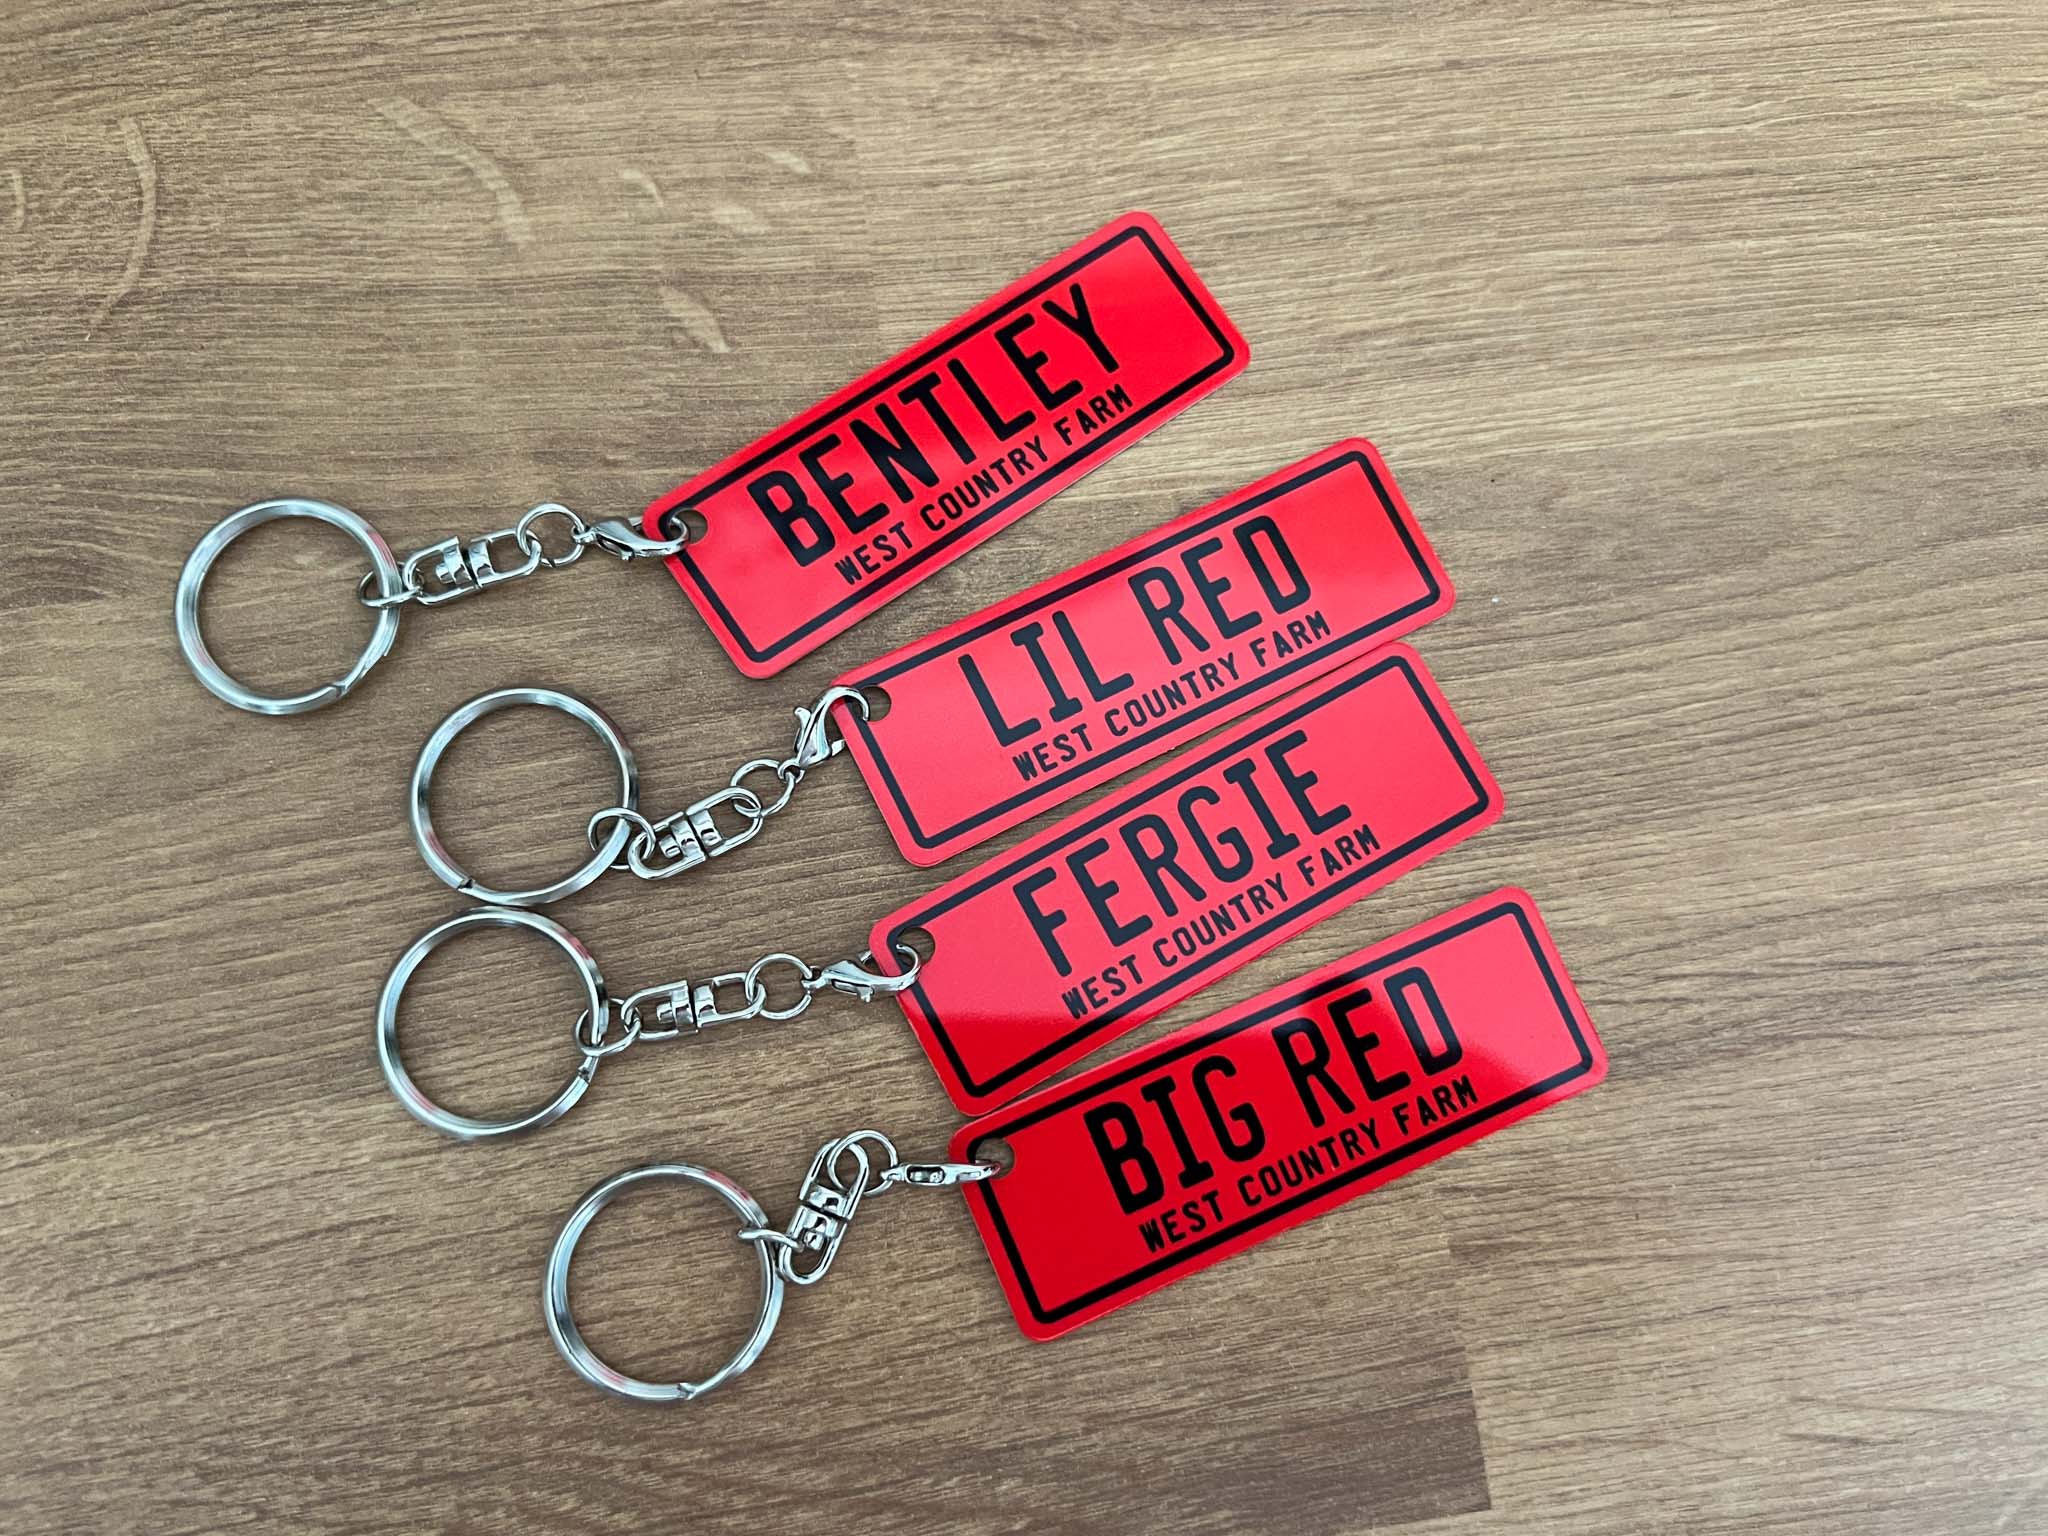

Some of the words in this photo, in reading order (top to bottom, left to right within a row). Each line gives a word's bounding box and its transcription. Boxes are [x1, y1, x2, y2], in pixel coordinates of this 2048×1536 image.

[746, 283, 1119, 567] BENTLEY
[834, 521, 913, 585] WEST
[920, 435, 1048, 532] COUNTRY
[1054, 383, 1133, 446] FARM
[958, 610, 1134, 747] LIL
[1127, 515, 1311, 666] RED
[1012, 723, 1092, 781] WEST
[1104, 652, 1239, 737] COUNTRY
[1249, 611, 1330, 667] FARM
[1012, 730, 1352, 977] FERGIE
[1061, 954, 1143, 1020] WEST
[1153, 872, 1288, 967] COUNTRY
[1297, 824, 1380, 887] FARM
[1083, 1055, 1266, 1215] BIG
[1271, 967, 1463, 1129] RED
[1138, 1189, 1224, 1253] WEST
[1237, 1118, 1381, 1207] COUNTRY
[1392, 1075, 1478, 1136] FARM
